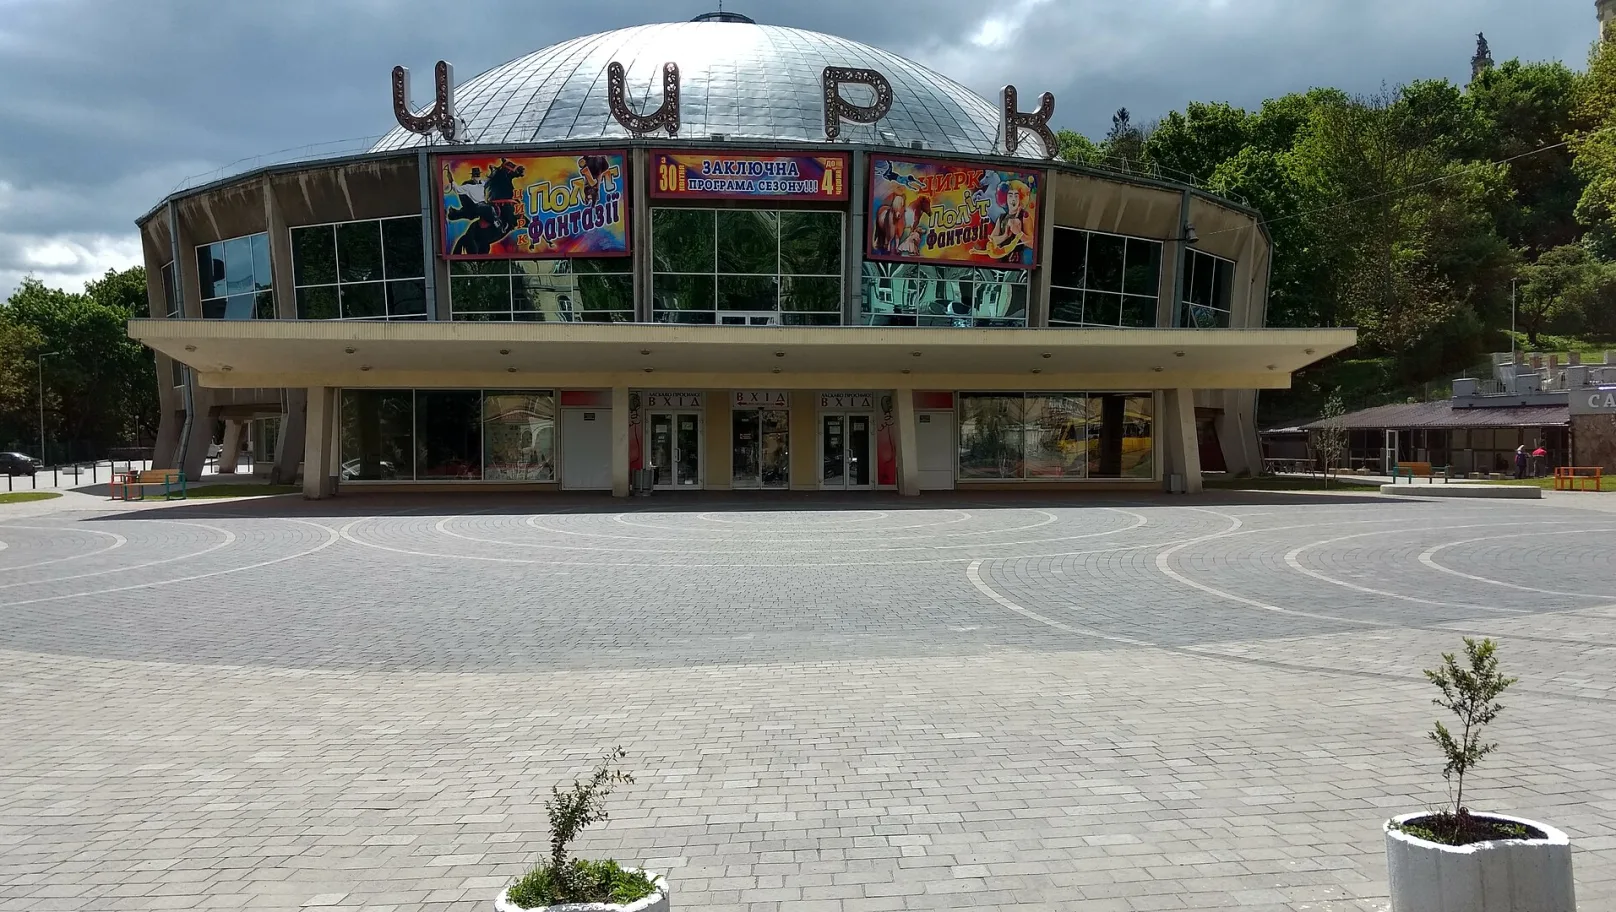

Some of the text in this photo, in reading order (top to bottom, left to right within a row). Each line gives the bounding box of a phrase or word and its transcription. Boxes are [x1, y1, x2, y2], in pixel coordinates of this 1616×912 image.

[392, 60, 1059, 159] ЦИРК
[659, 164, 677, 192] 30
[702, 160, 799, 177] ЗАКЛЮЧНА
[688, 178, 819, 193] ПРОГРАМА СЕЗОНУ!!!
[822, 169, 834, 195] 4
[918, 169, 984, 196] ЦИРК
